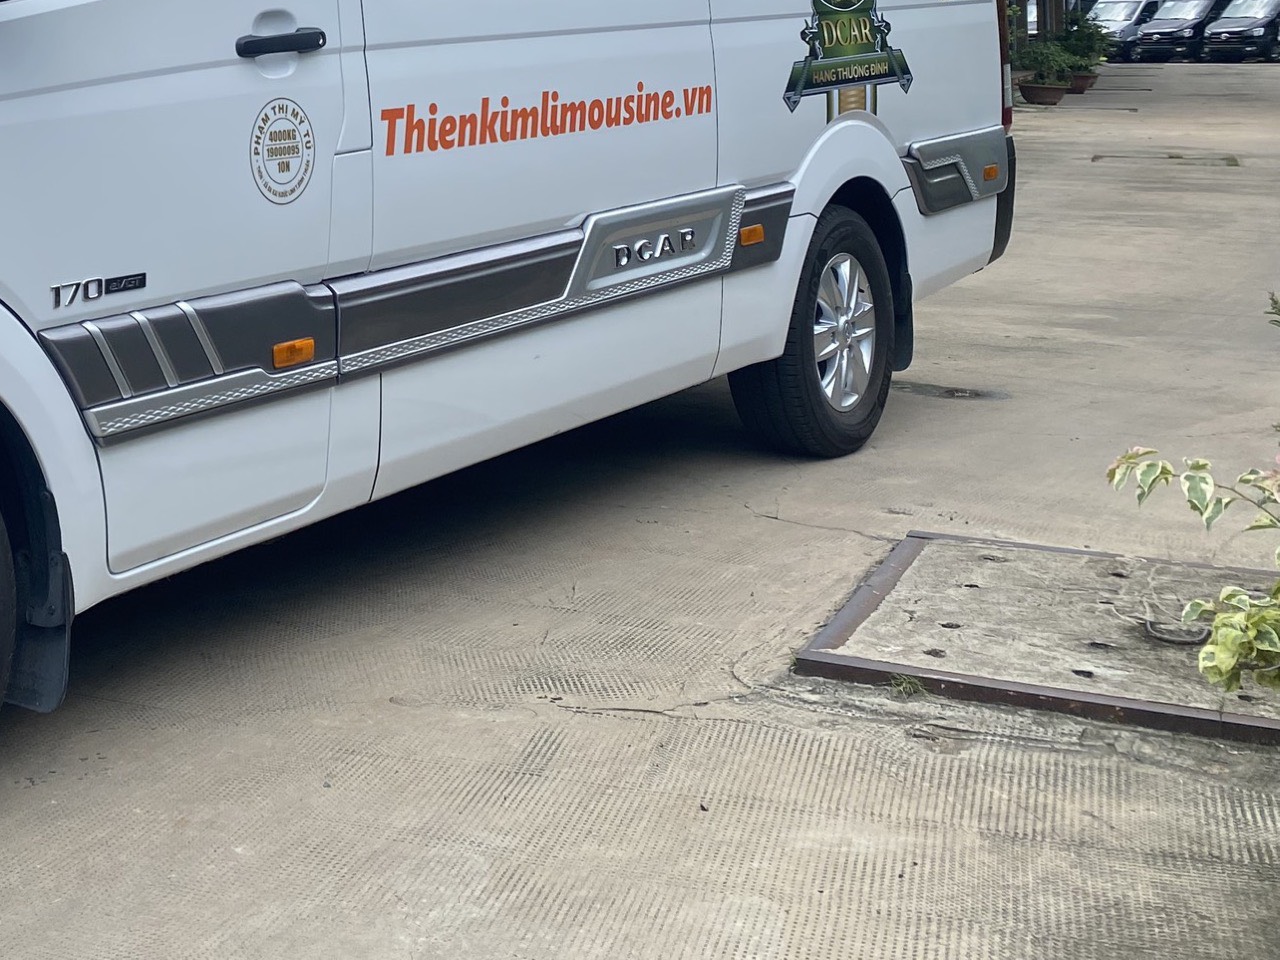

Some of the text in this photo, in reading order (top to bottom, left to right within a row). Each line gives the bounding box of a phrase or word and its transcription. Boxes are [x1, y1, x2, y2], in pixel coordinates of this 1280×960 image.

[821, 16, 874, 48] DCAR
[253, 112, 271, 156] PHẠM
[271, 104, 288, 118] THỊ
[268, 128, 297, 143] 4000KG
[380, 81, 712, 157] Thienkimlimousine.vn
[266, 144, 300, 159] 19000095
[612, 228, 696, 268] DCAR
[50, 276, 103, 309] 170
